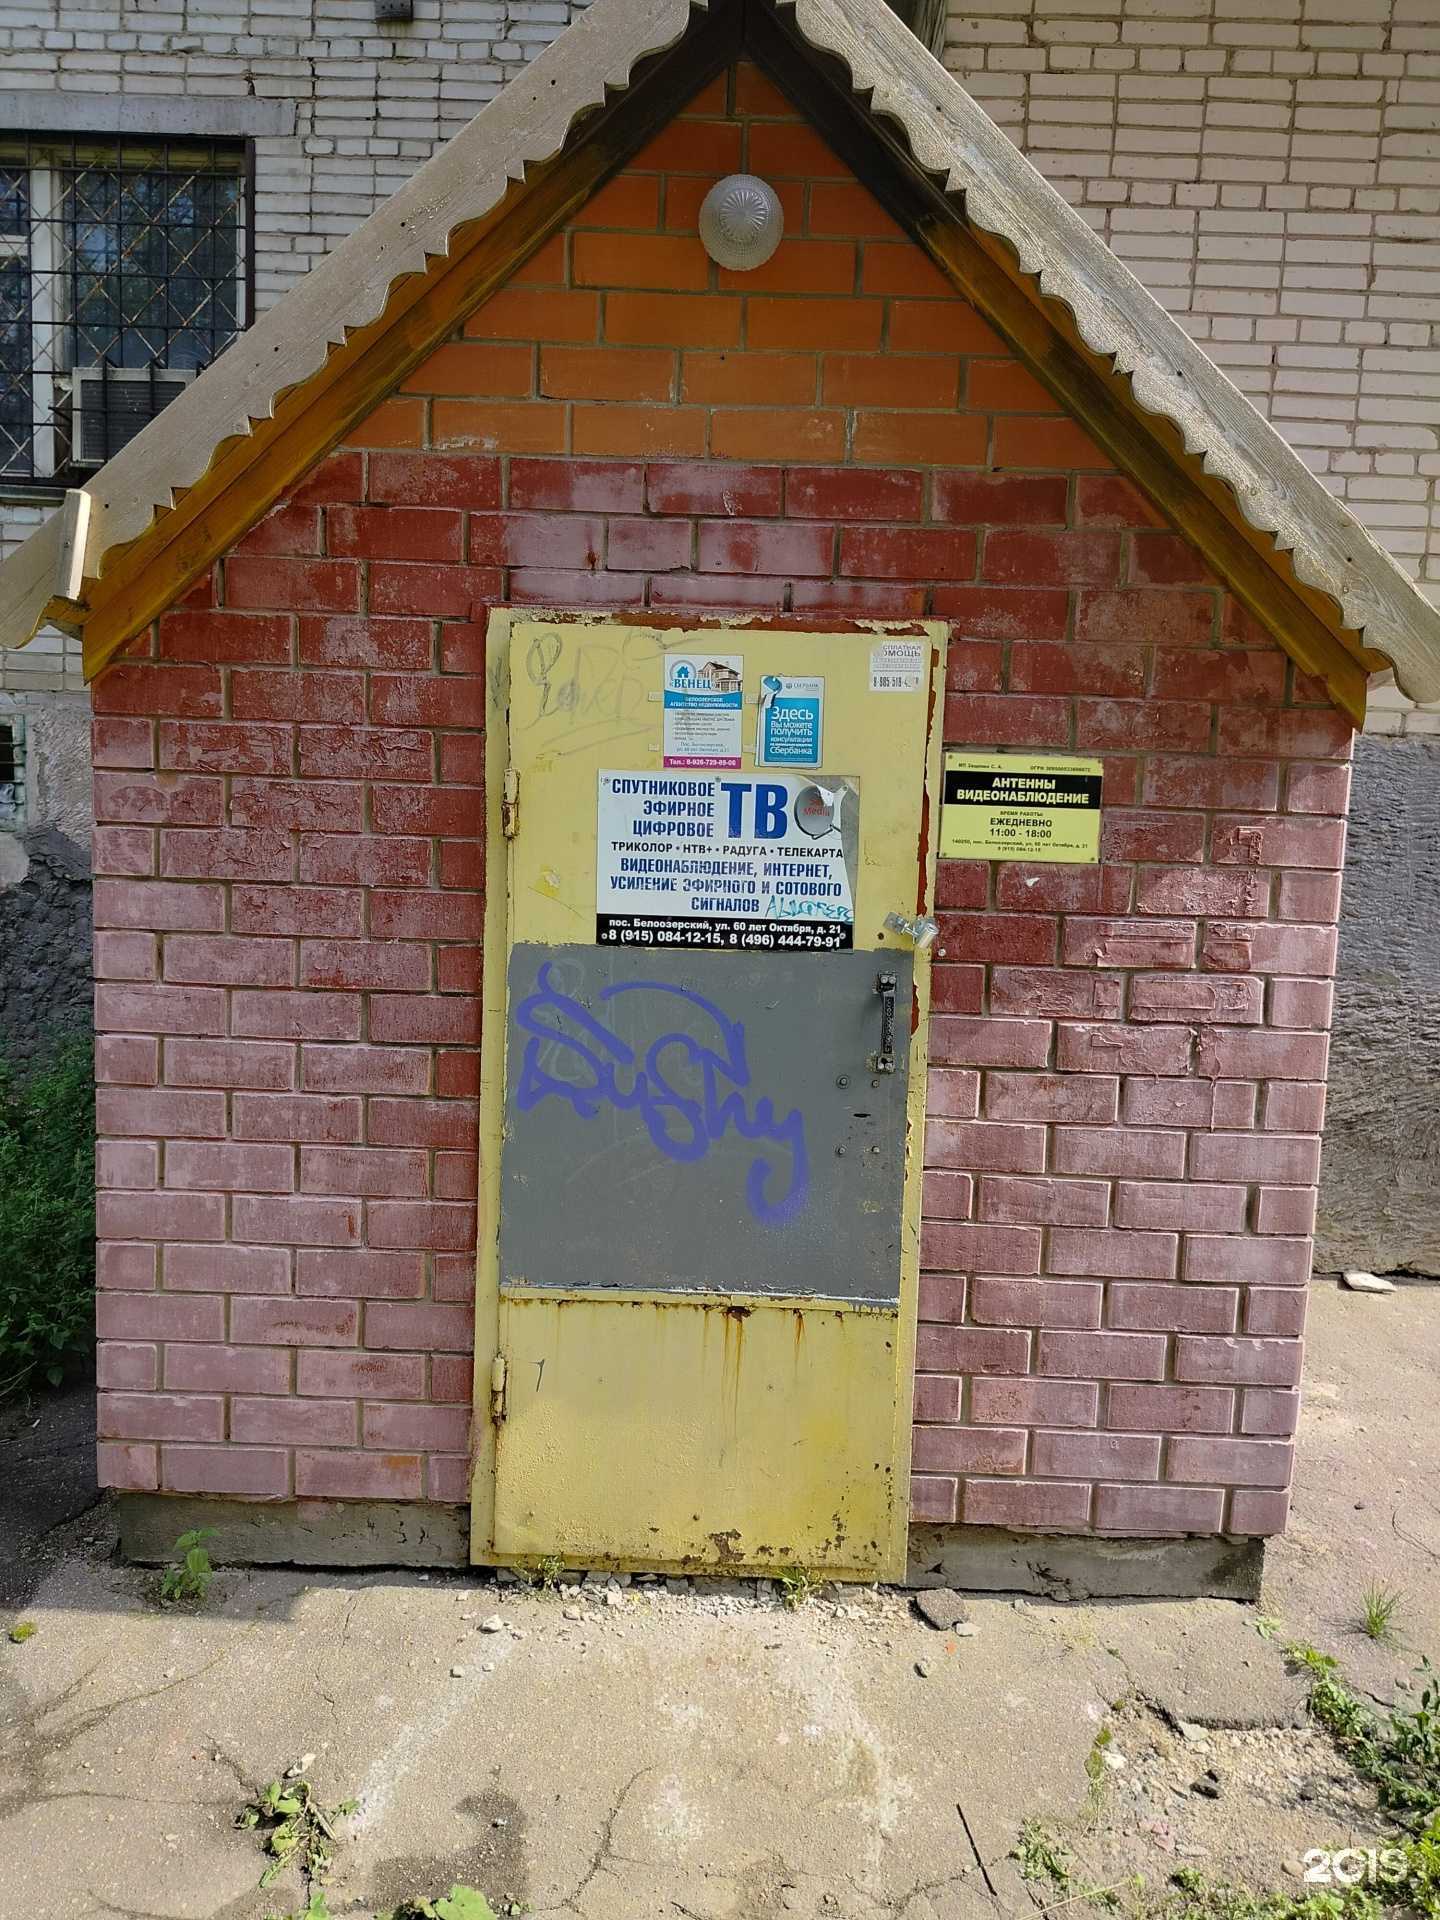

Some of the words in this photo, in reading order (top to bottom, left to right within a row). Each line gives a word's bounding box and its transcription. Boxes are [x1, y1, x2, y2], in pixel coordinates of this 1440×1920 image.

[674, 678, 711, 689] ВЕНЕЦ
[771, 706, 814, 722] Здесь
[771, 720, 782, 728] Вы
[770, 728, 813, 737] получить
[770, 746, 813, 756] Сбербанка
[992, 777, 1056, 790] АНТЕННЫ
[956, 789, 1090, 805] ВИДЕОНАБЛЮДЕНИЕ
[612, 778, 715, 797] СПУТНИКОВОЕ
[720, 782, 788, 840] ТВ
[643, 799, 715, 818] ЭФИРНОЕ
[633, 820, 715, 838] ЦИФРОВОЕ
[990, 817, 1053, 828] ЕЖЕДНЕВНО
[990, 828, 1016, 838] 11:00
[1025, 830, 1052, 839] 18:00
[611, 841, 673, 853] ТРИКОЛОР
[682, 844, 713, 854] НТВ+
[722, 845, 767, 857] РАДУГА
[777, 847, 844, 859] ТЕЛЕКАРТА
[620, 857, 758, 877] ВИДЕОНАБЛЮДЕНИЕ,
[763, 863, 833, 880] ИНТЕРНЕТ,
[610, 876, 678, 892] УСИЛЕНИЕ
[682, 878, 756, 894] ЭФИРНОГО
[761, 881, 770, 894] И
[775, 881, 842, 897] СОТОВОГО
[691, 897, 760, 913] СИГНАЛОВ
[609, 919, 631, 928] пос.
[633, 918, 713, 931] Белоозерский,
[715, 921, 731, 932] ул.
[733, 921, 746, 931] 60
[748, 923, 767, 932] лет
[769, 923, 815, 935] Октября,
[816, 926, 828, 935] д.
[829, 925, 841, 934] 21
[608, 930, 617, 941] 8
[620, 929, 654, 943] (915)
[657, 931, 724, 945] 084-12-15,
[729, 933, 738, 945] 8
[741, 933, 774, 947] (496)
[777, 934, 842, 947] 444-79-91
